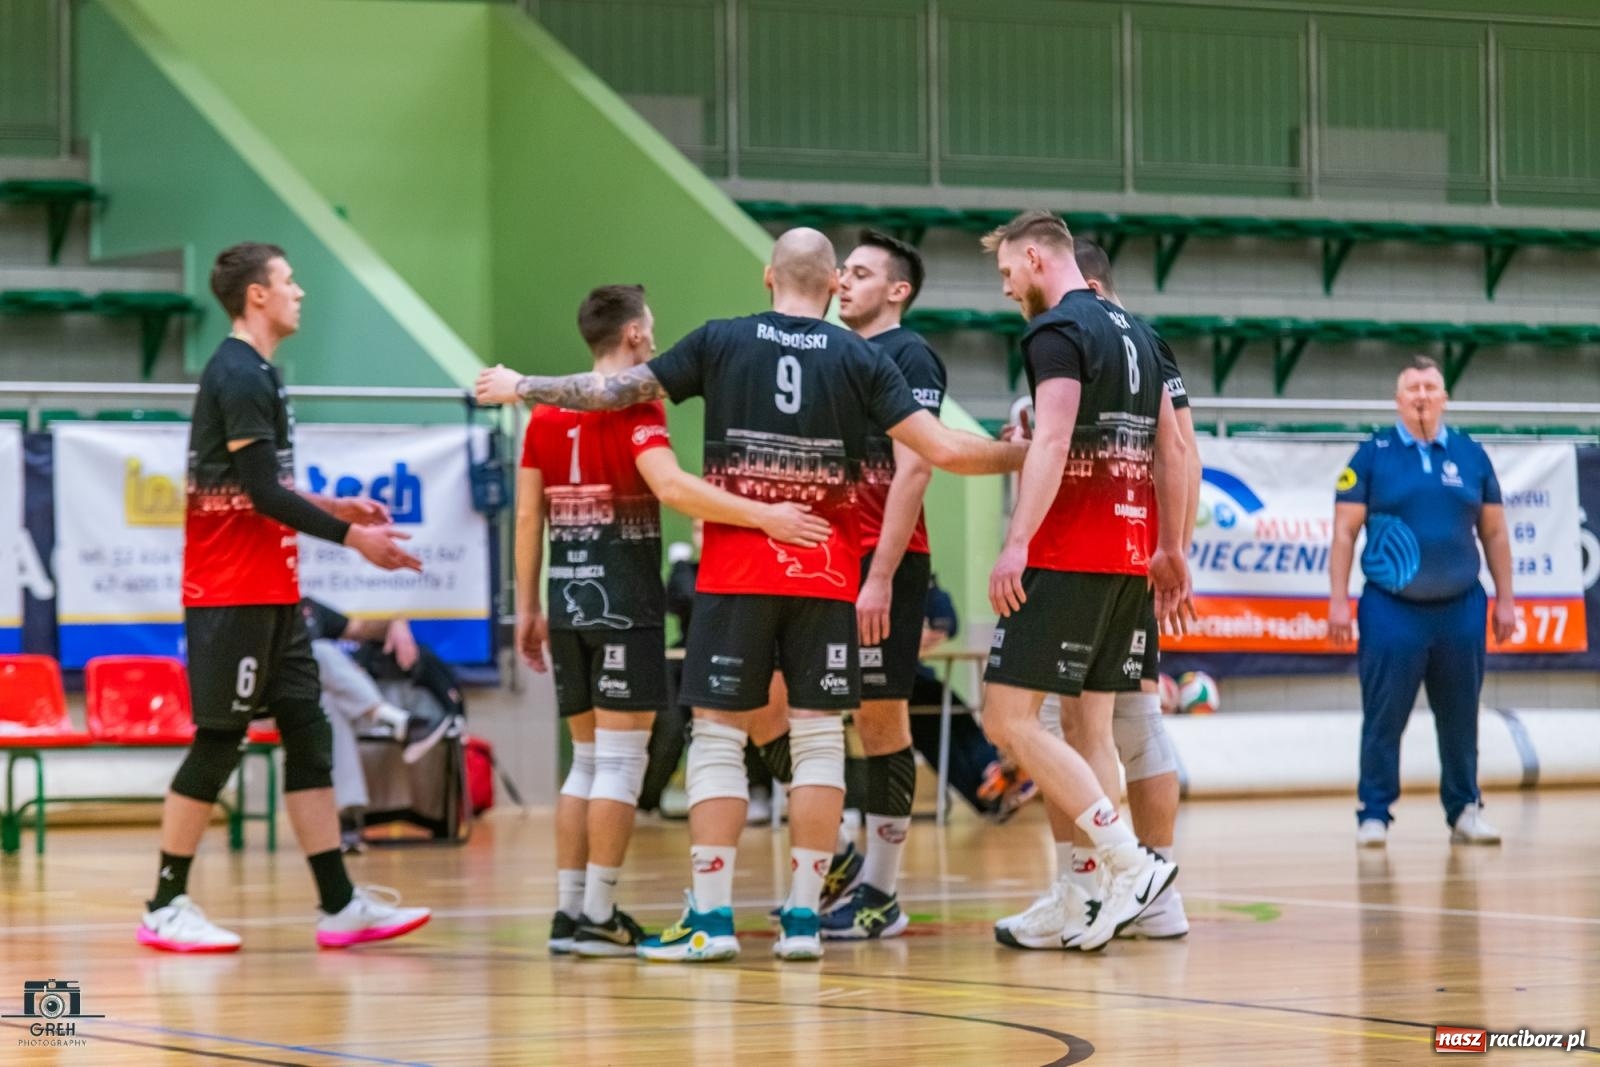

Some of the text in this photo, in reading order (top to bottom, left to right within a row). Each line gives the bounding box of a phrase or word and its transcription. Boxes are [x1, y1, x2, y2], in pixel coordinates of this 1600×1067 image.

[774, 355, 802, 415] 9
[1122, 335, 1141, 395] 8
[567, 425, 582, 484] 1
[1532, 606, 1568, 644] 77
[236, 656, 258, 698] 6
